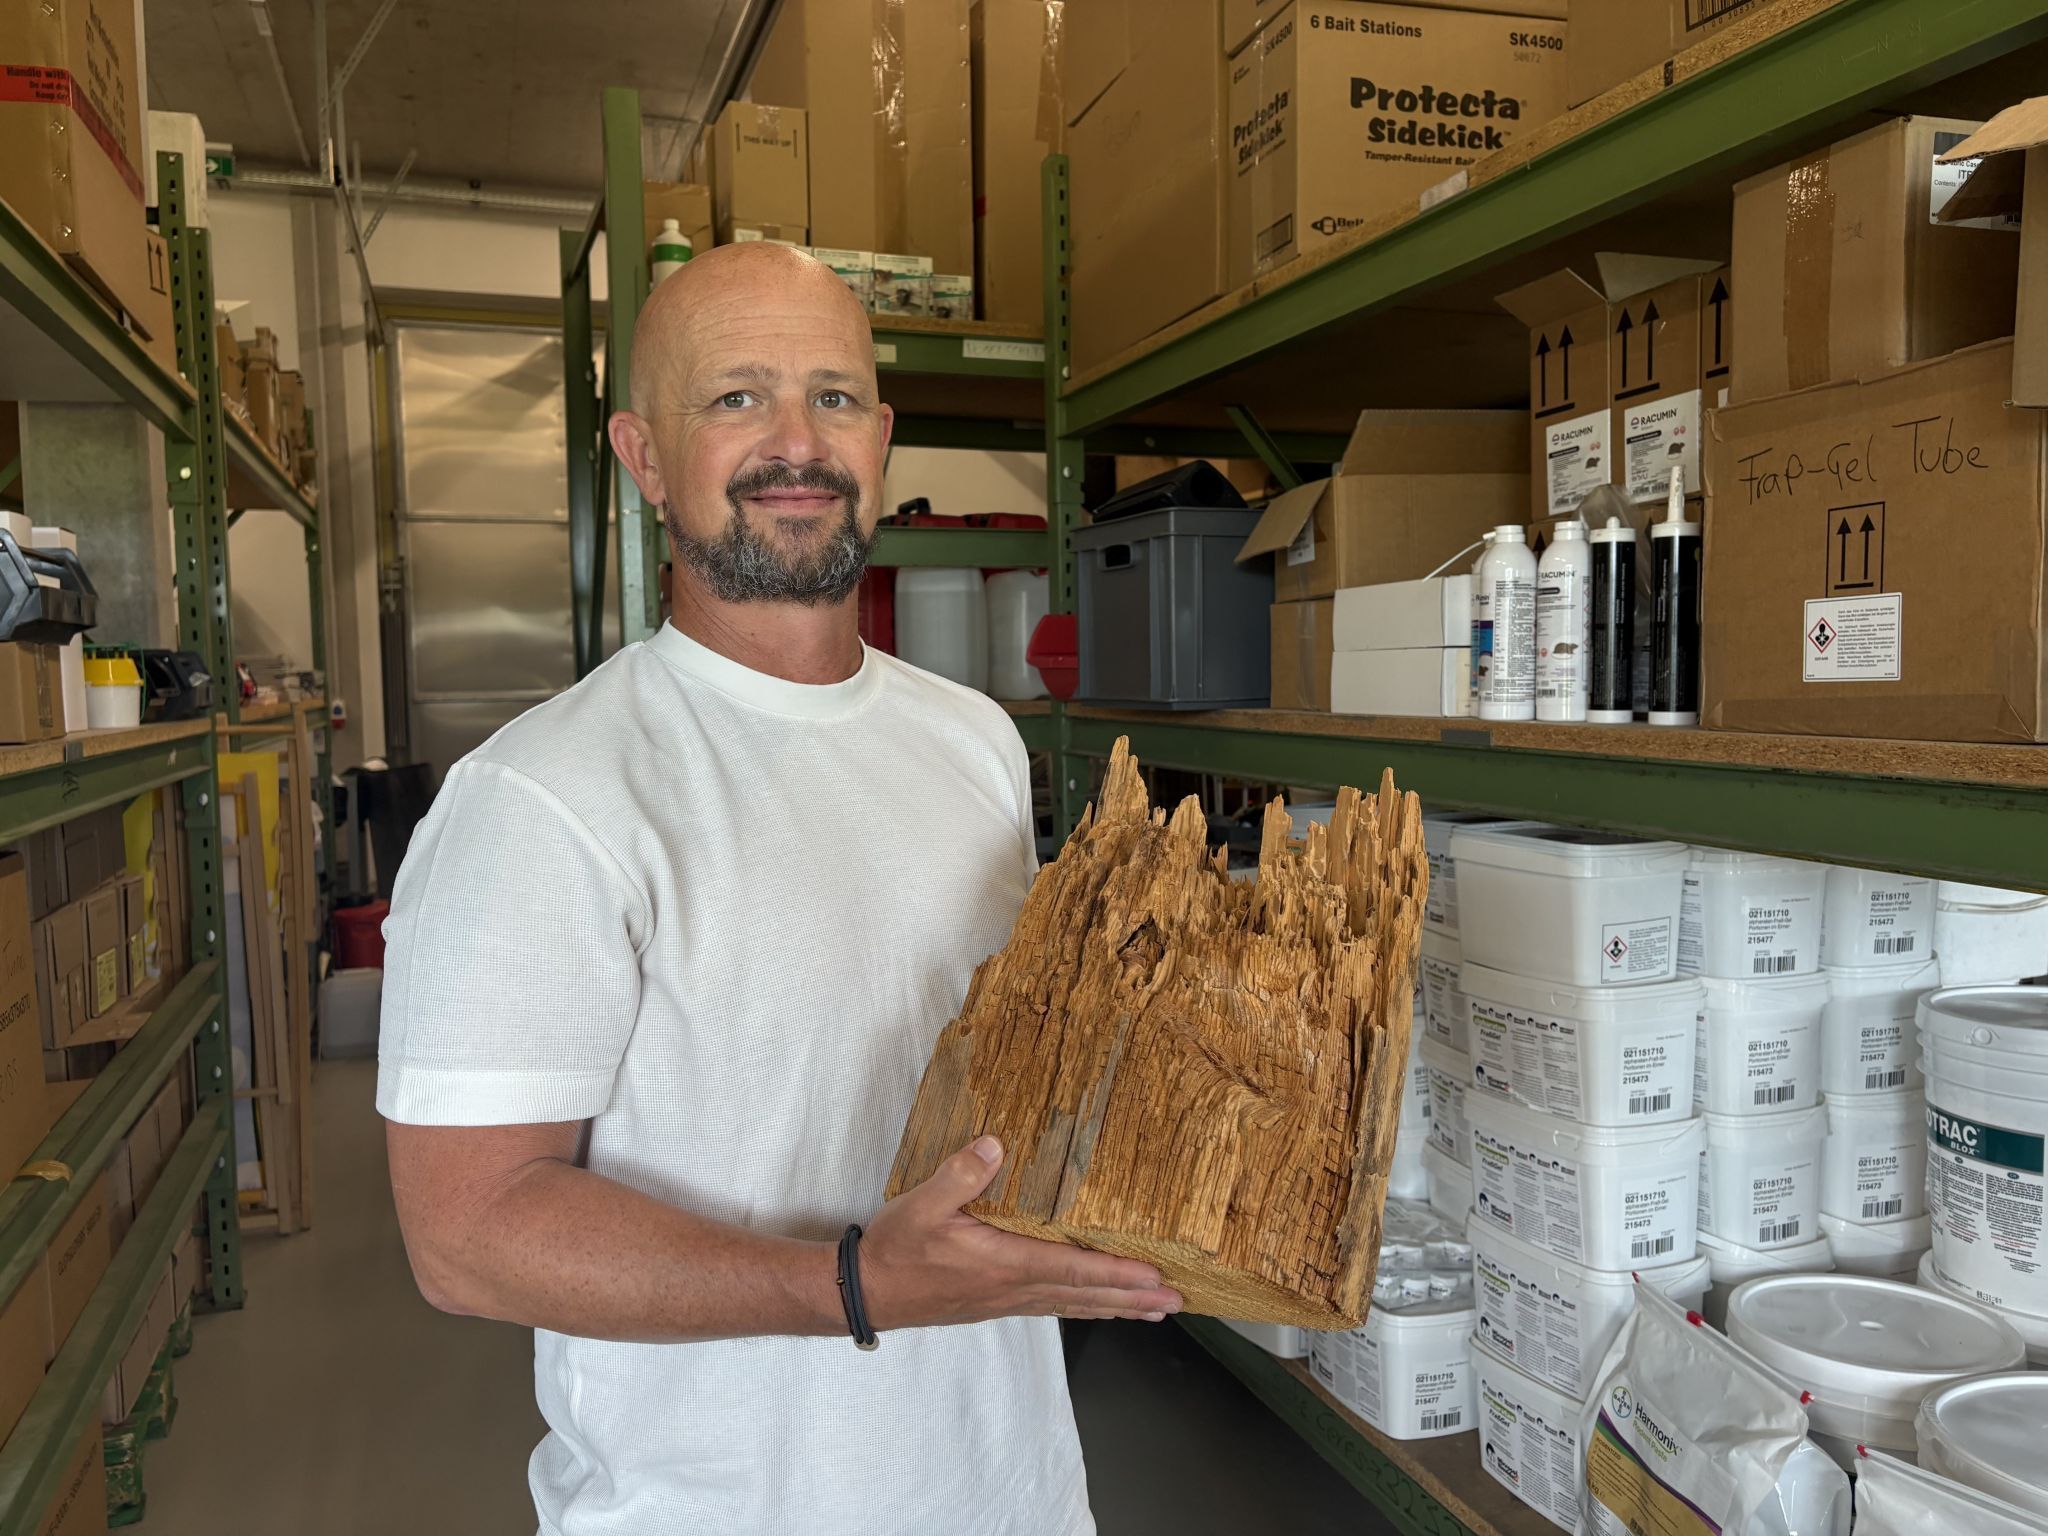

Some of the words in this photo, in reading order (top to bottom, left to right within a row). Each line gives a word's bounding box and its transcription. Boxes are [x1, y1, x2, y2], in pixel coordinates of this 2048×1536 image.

[1310, 14, 1320, 29] 6
[1325, 15, 1355, 33] Bait
[1360, 18, 1423, 38] Stations
[1509, 31, 1564, 51] SK4500
[1350, 77, 1521, 120] Protecta
[1233, 91, 1290, 147] Protecta
[1368, 117, 1504, 151] Sidekick
[1238, 118, 1283, 165] Sidekick
[1365, 150, 1453, 166] Tamper-Resistant
[1640, 408, 1678, 426] RACUMIN
[1560, 425, 1593, 442] RACUMIN
[1891, 414, 1990, 475] Tube
[1871, 892, 1910, 901] 021151710
[1748, 908, 1790, 918] 021151710
[1869, 918, 1894, 926] 215473
[1747, 935, 1773, 944] 215477
[1861, 1026, 1900, 1037] 021151710
[1748, 1039, 1788, 1051] 021151710
[1623, 1046, 1664, 1058] 021151710
[1860, 1053, 1885, 1062] 215473
[1747, 1067, 1773, 1077] 215473
[1622, 1075, 1649, 1085] 215473
[1950, 1141, 1976, 1156] BLOX
[1858, 1156, 1897, 1167] 021151710
[1753, 1176, 1792, 1190] 021151710
[1857, 1182, 1882, 1191] 215473
[1625, 1190, 1666, 1204] 021151710
[1753, 1204, 1778, 1215] 215473
[1625, 1218, 1651, 1230] 215473
[1415, 1371, 1455, 1384] 021151710
[1415, 1396, 1440, 1406] 215477
[1635, 1401, 1679, 1456] Harmonix
